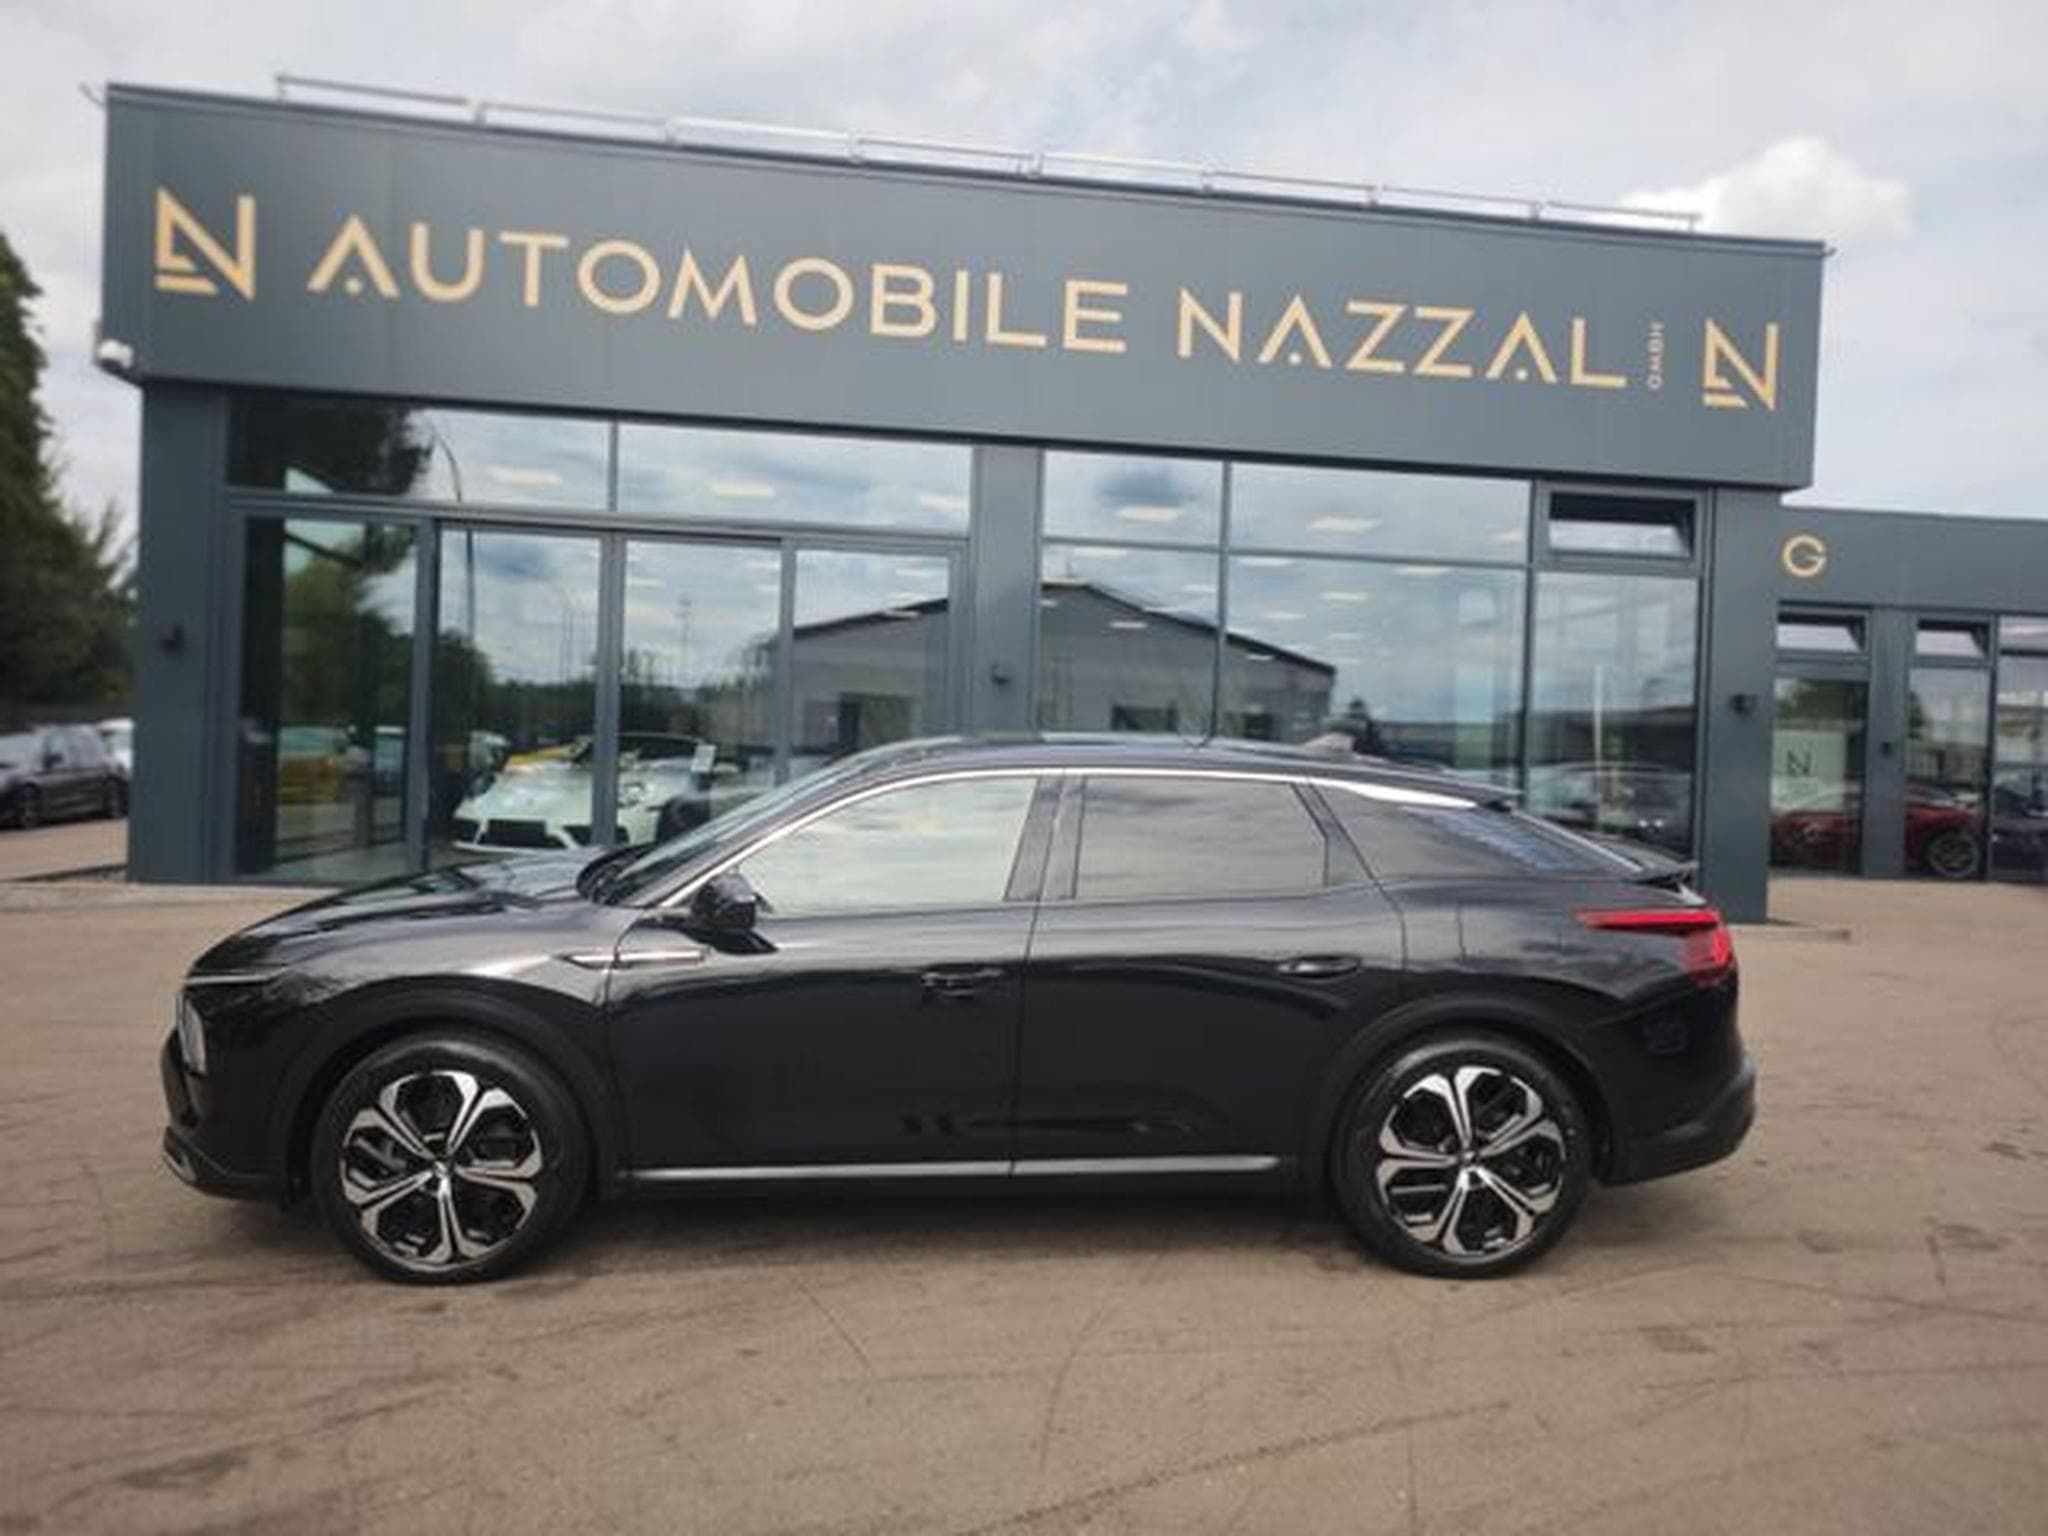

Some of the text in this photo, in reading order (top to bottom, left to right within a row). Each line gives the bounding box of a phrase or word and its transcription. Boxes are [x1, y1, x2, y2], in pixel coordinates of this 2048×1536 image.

[307, 214, 1628, 390] AUTOMOBILE NAZZAL
[1782, 534, 1827, 578] G
